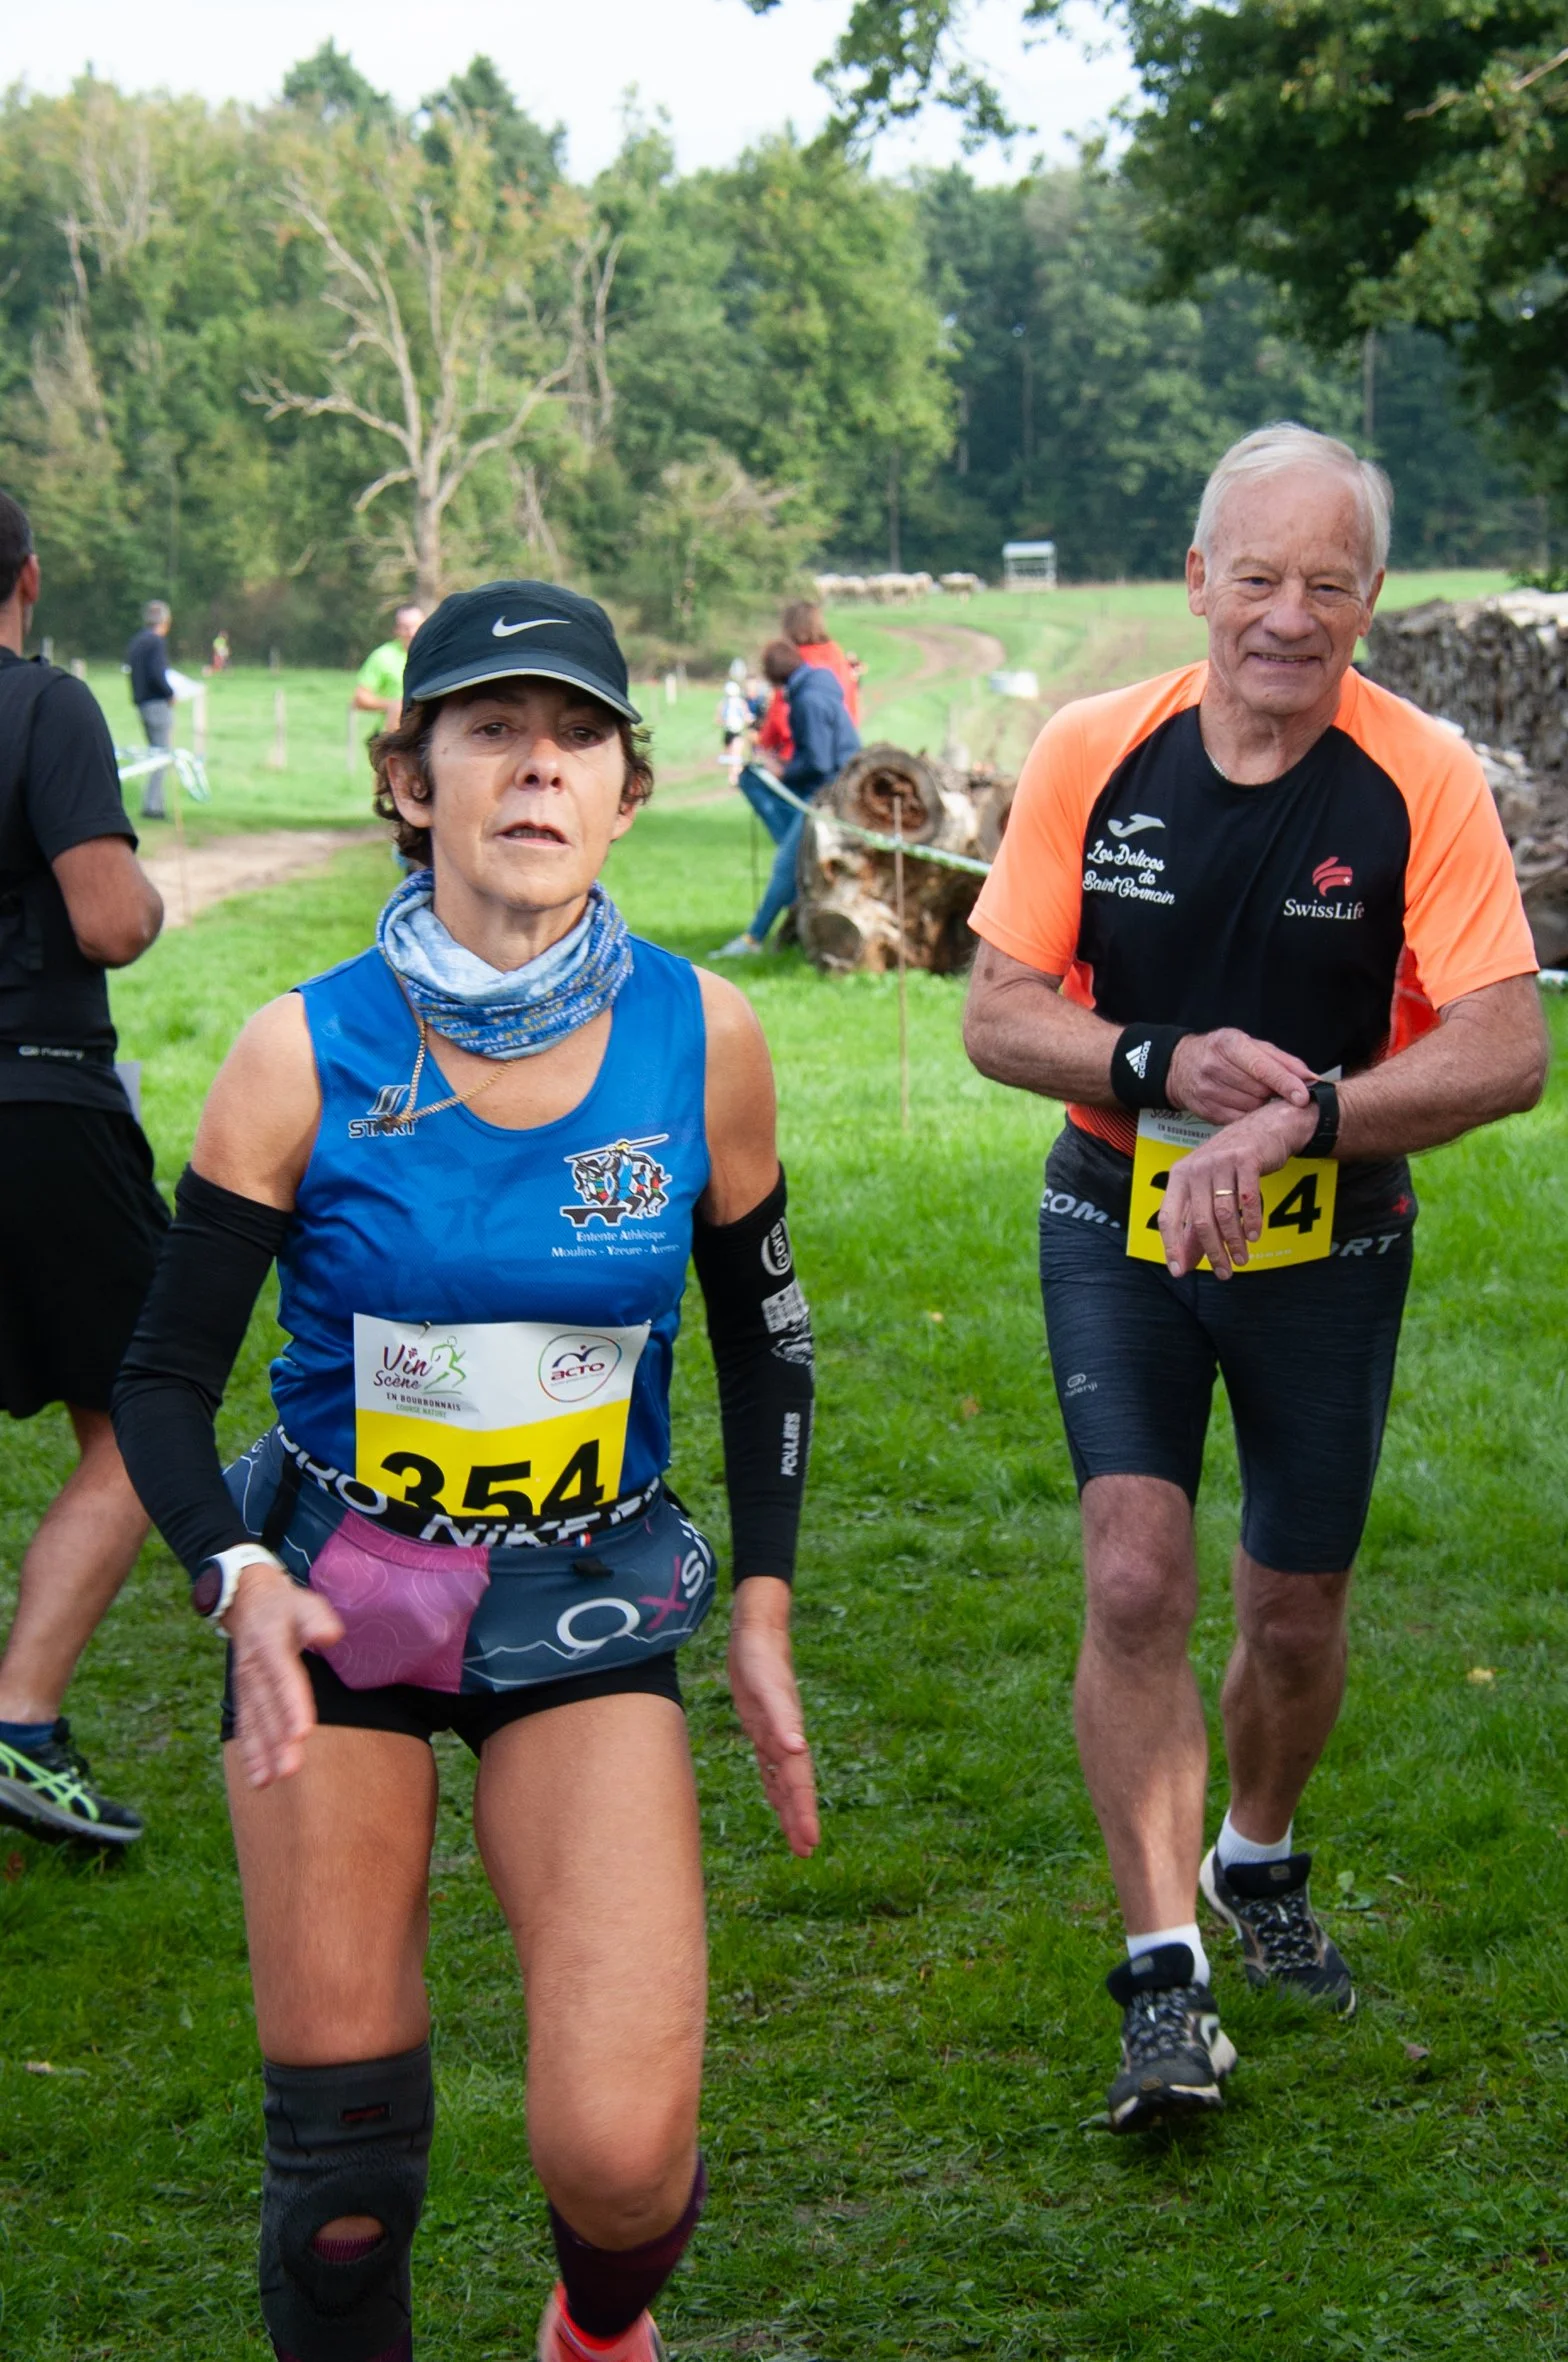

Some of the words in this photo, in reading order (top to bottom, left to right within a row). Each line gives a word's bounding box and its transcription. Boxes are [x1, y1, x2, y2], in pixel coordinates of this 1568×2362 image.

[1082, 870, 1121, 891] Saint
[1118, 877, 1175, 905] Germain
[1041, 1188, 1121, 1229] COM
[551, 1246, 597, 1258] Moulins
[400, 1394, 461, 1412] BOURBONNAIS
[380, 1439, 605, 1518] 354
[420, 1511, 601, 1548] NIKE
